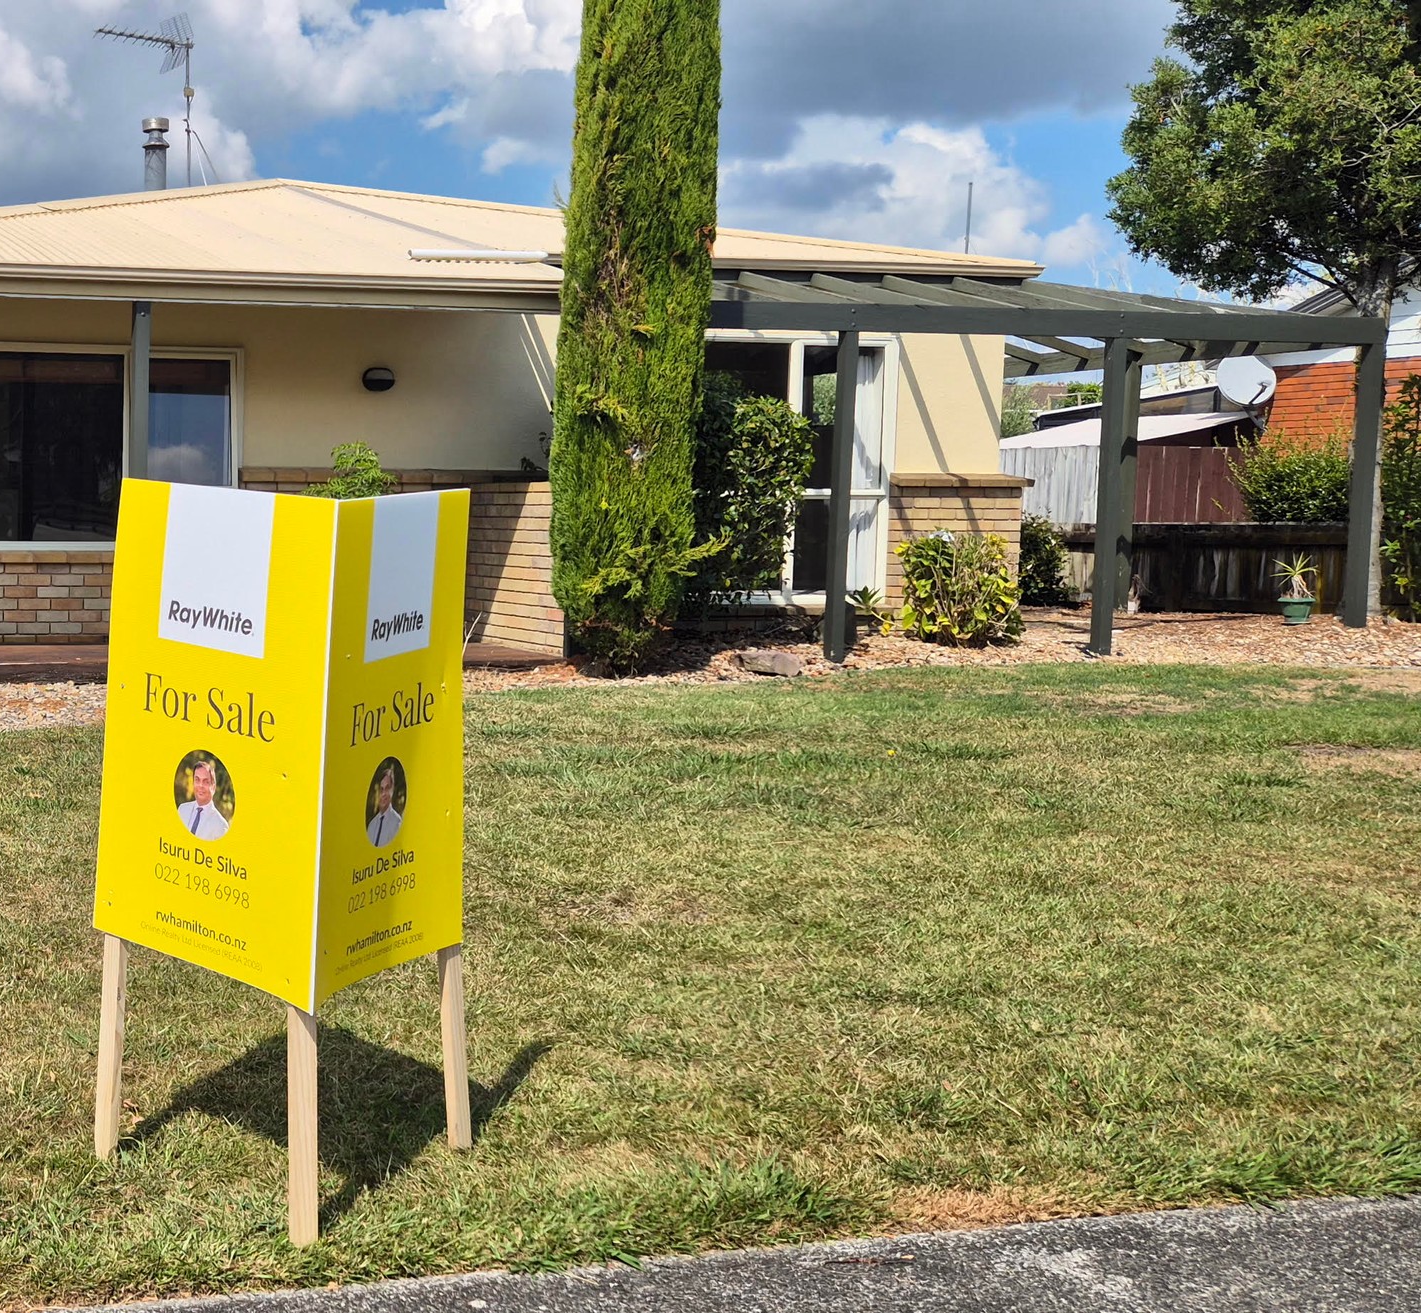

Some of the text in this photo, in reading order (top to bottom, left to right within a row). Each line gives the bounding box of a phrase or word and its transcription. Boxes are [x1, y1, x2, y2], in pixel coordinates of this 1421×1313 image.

[168, 599, 254, 636] RayWhite
[371, 610, 424, 642] RayWhite
[143, 672, 275, 743] For Sale
[350, 682, 434, 747] For Sale
[159, 837, 247, 880] Isuru De Silva
[352, 849, 414, 885] Isuru De Silva
[154, 862, 250, 909] 022 198 6998
[348, 872, 416, 914] 022 198 6998
[156, 910, 247, 951] rwhamilton.co.nz
[182, 936, 191, 946] Ltd
[346, 920, 413, 956] rwhamilton.co.nz
